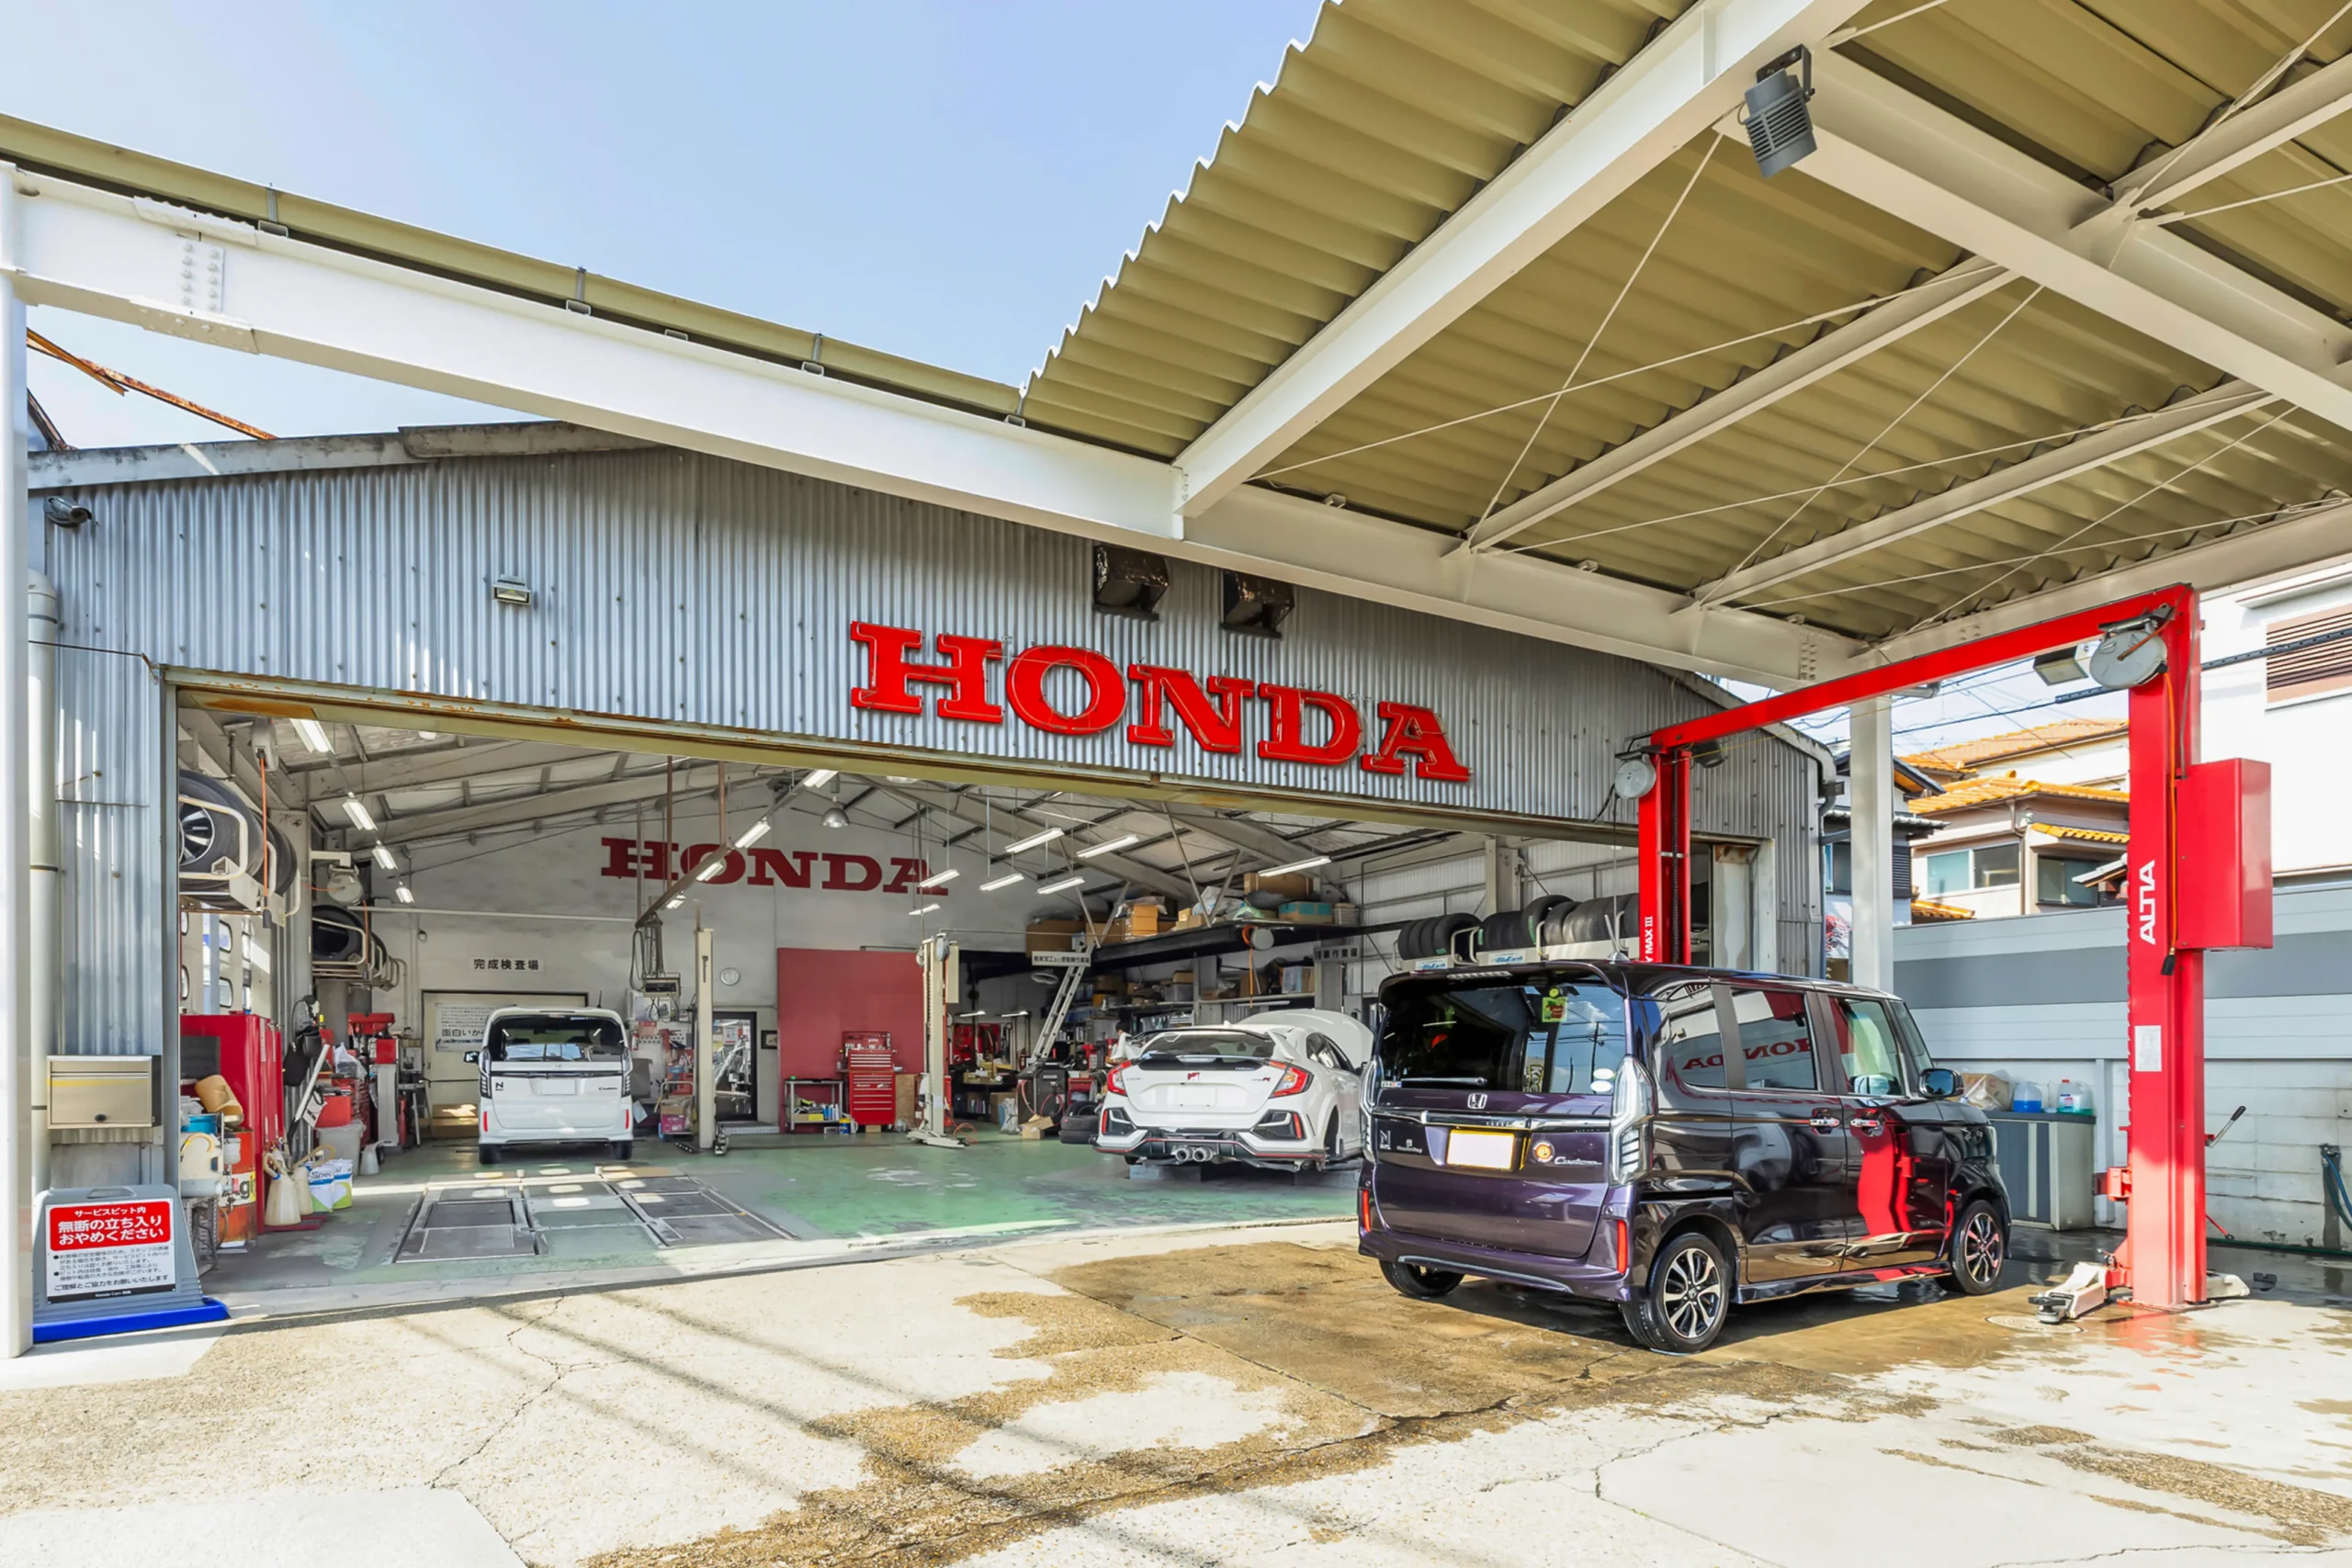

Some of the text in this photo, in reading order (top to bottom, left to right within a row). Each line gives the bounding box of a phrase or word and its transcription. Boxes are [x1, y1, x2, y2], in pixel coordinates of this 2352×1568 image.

[851, 621, 1471, 782] HONDA
[601, 837, 948, 896] HONDA
[1645, 929, 1653, 954] MAX
[473, 959, 538, 970] 完成検査場
[1554, 1156, 1603, 1166] Custom
[58, 1215, 162, 1233] 無断の立ち入り
[58, 1228, 164, 1246] おやめください
